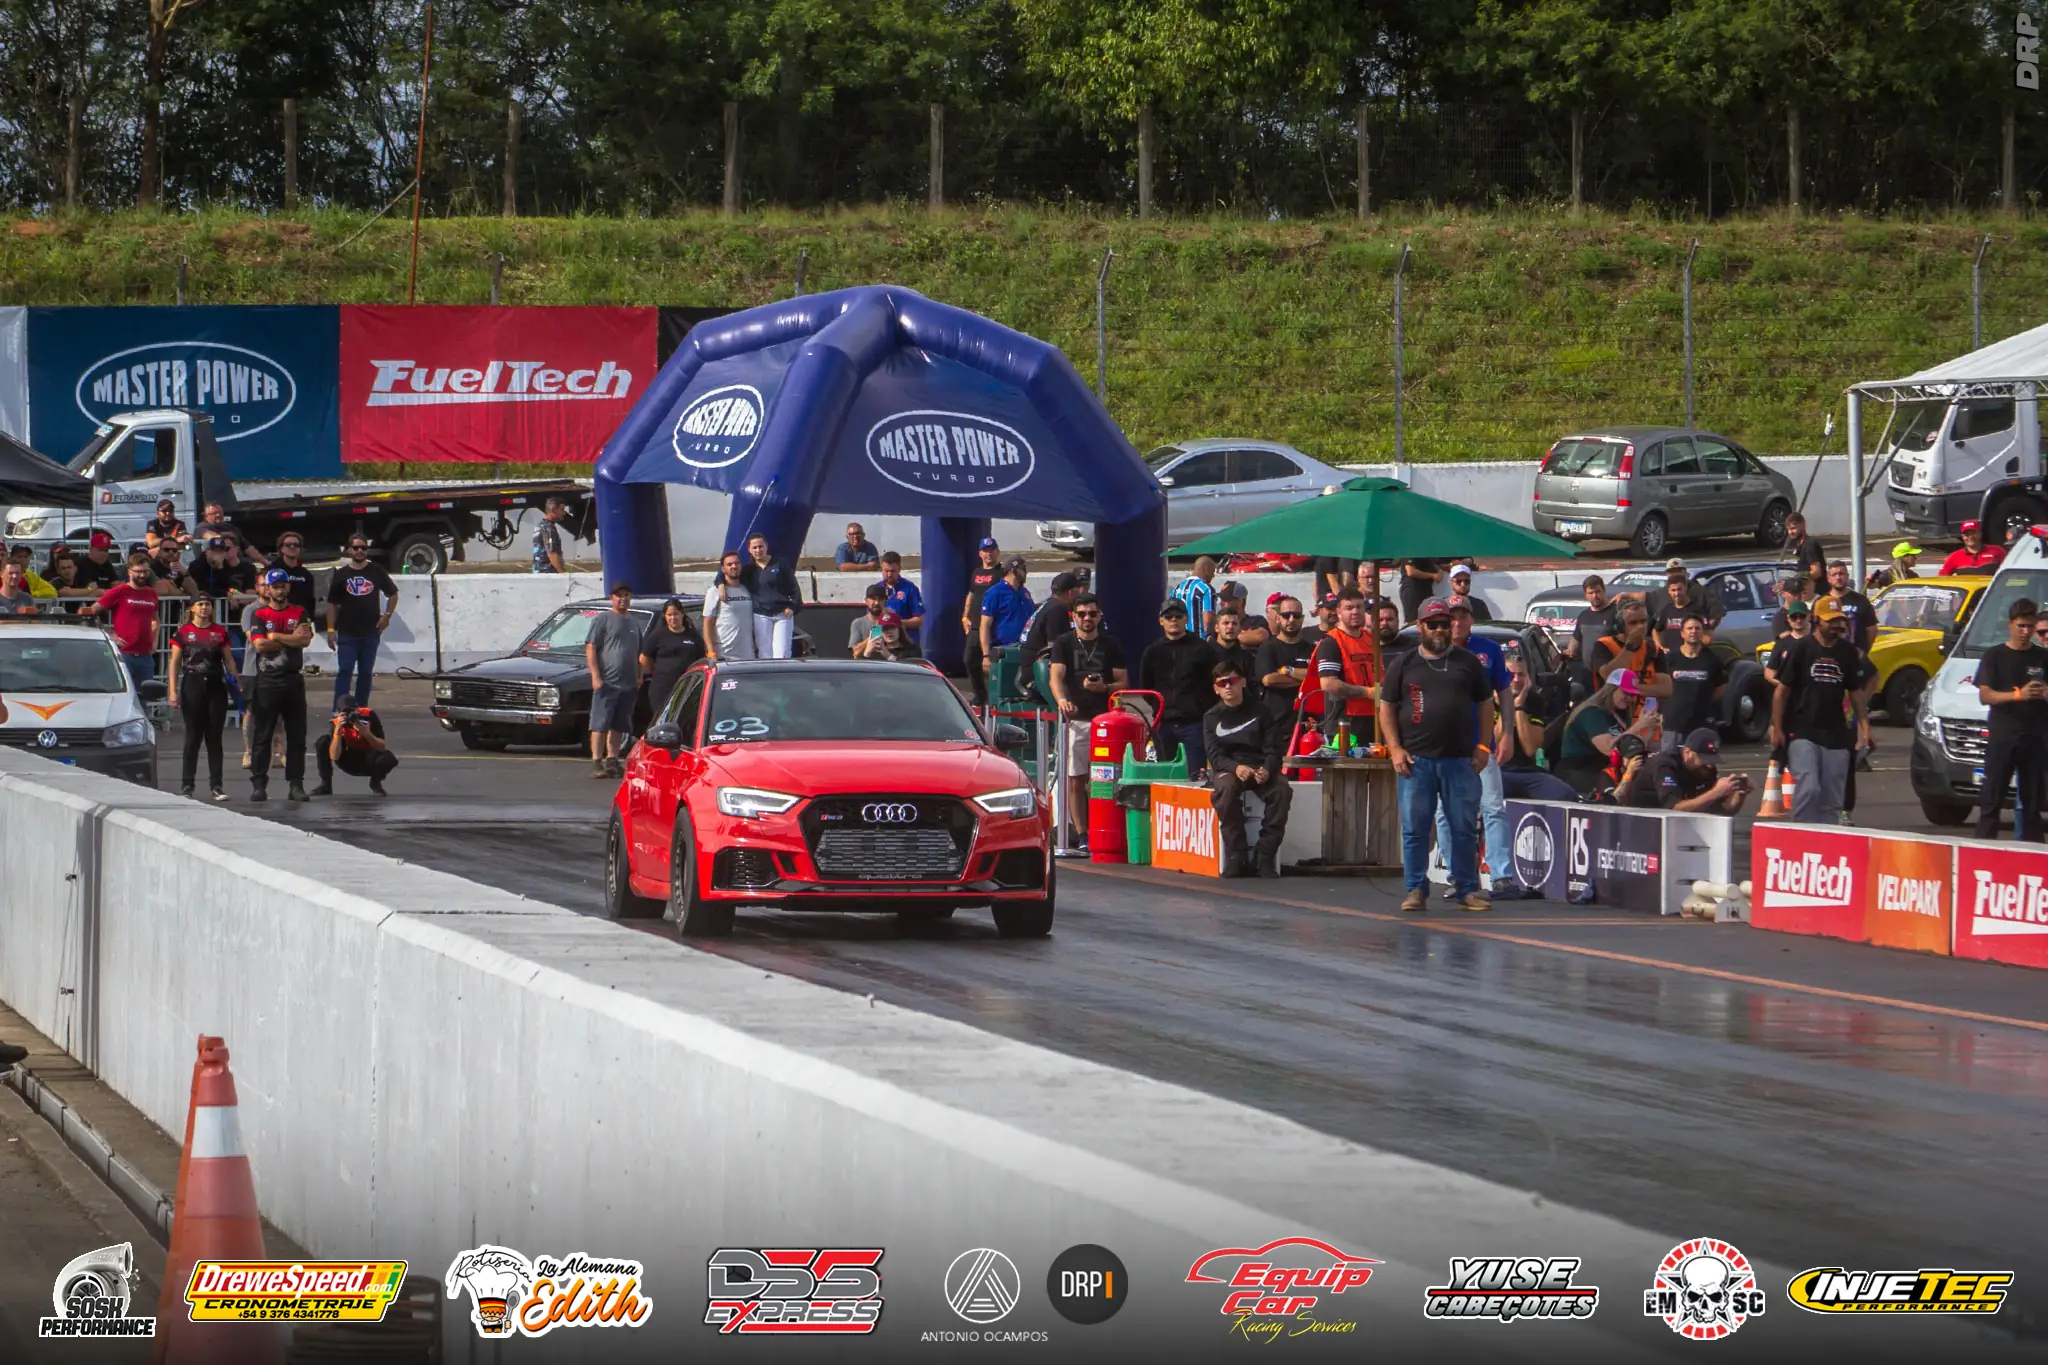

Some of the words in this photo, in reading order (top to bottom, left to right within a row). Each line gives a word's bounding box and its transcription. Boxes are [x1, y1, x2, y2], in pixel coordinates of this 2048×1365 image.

[93, 360, 188, 406] MASTER
[196, 360, 279, 405] POWER
[367, 359, 632, 402] FuelTech
[879, 424, 952, 466] MASTER
[951, 426, 1020, 467] POWER
[913, 471, 995, 484] TURBO
[715, 716, 769, 736] 03
[1155, 801, 1216, 859] VELOPARK
[1569, 817, 1591, 876] RS
[1764, 848, 1853, 905] FuelTech
[1877, 873, 1942, 918] VELOPARK
